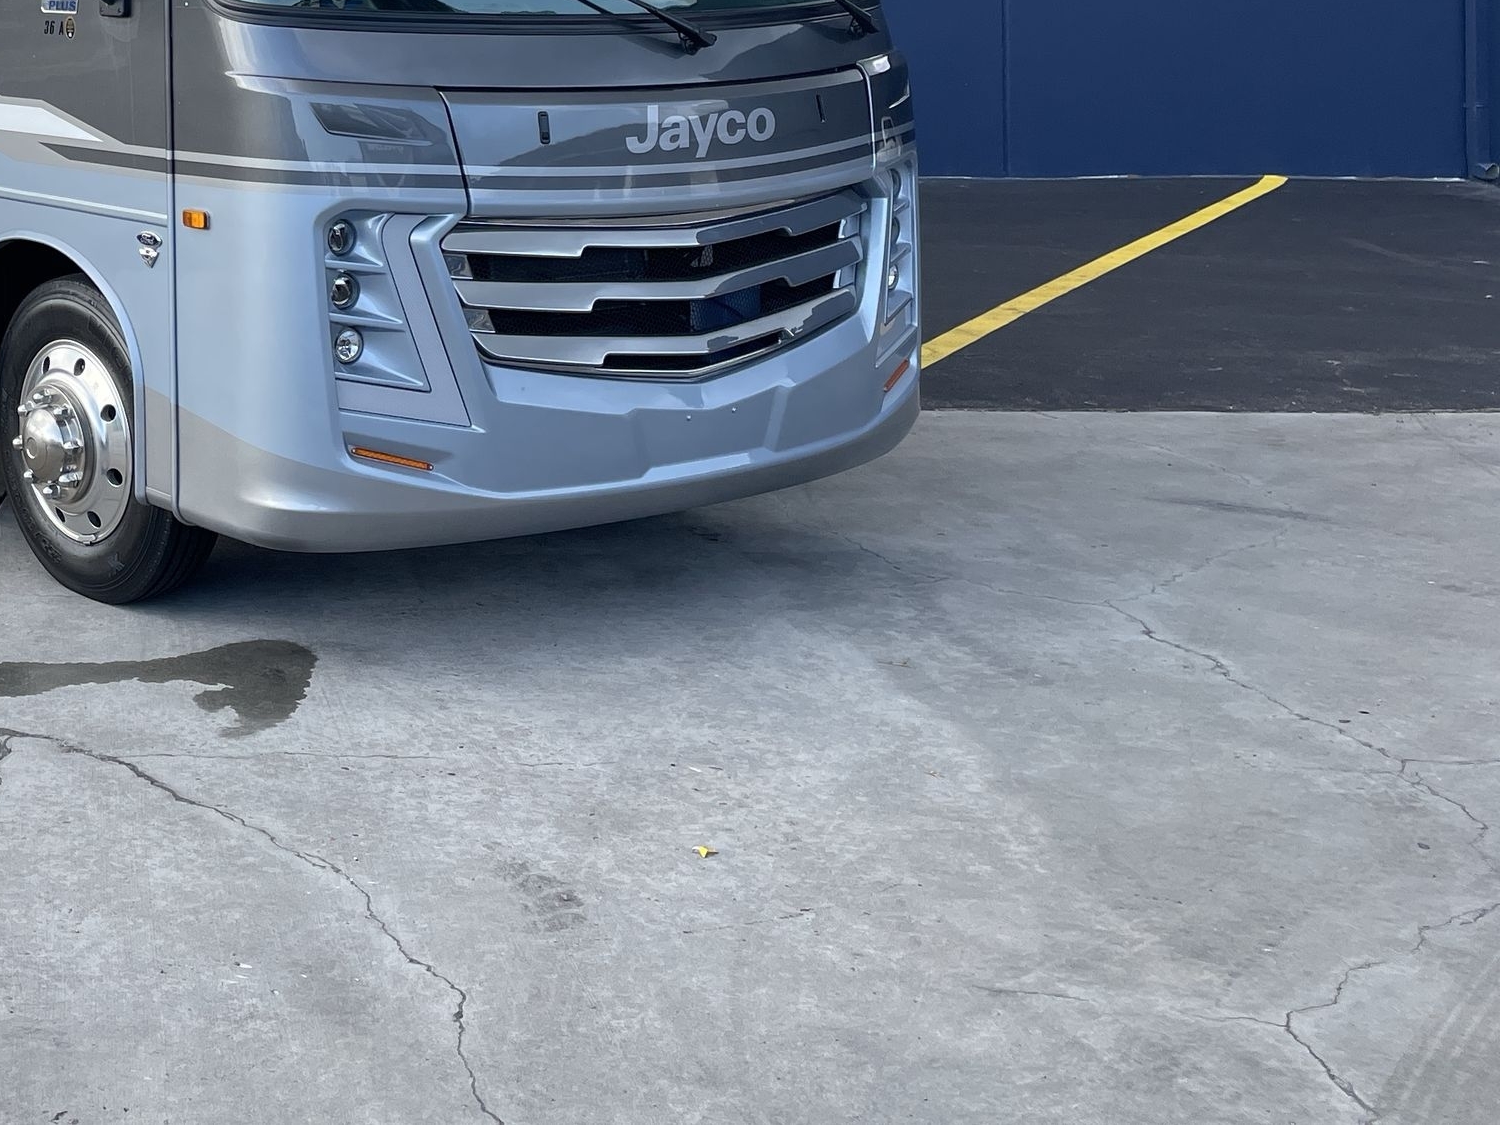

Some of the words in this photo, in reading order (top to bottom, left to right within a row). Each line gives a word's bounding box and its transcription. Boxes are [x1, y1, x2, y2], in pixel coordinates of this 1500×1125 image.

[49, 1, 76, 12] PLUS
[44, 20, 55, 35] 36
[625, 104, 776, 159] Jayco
